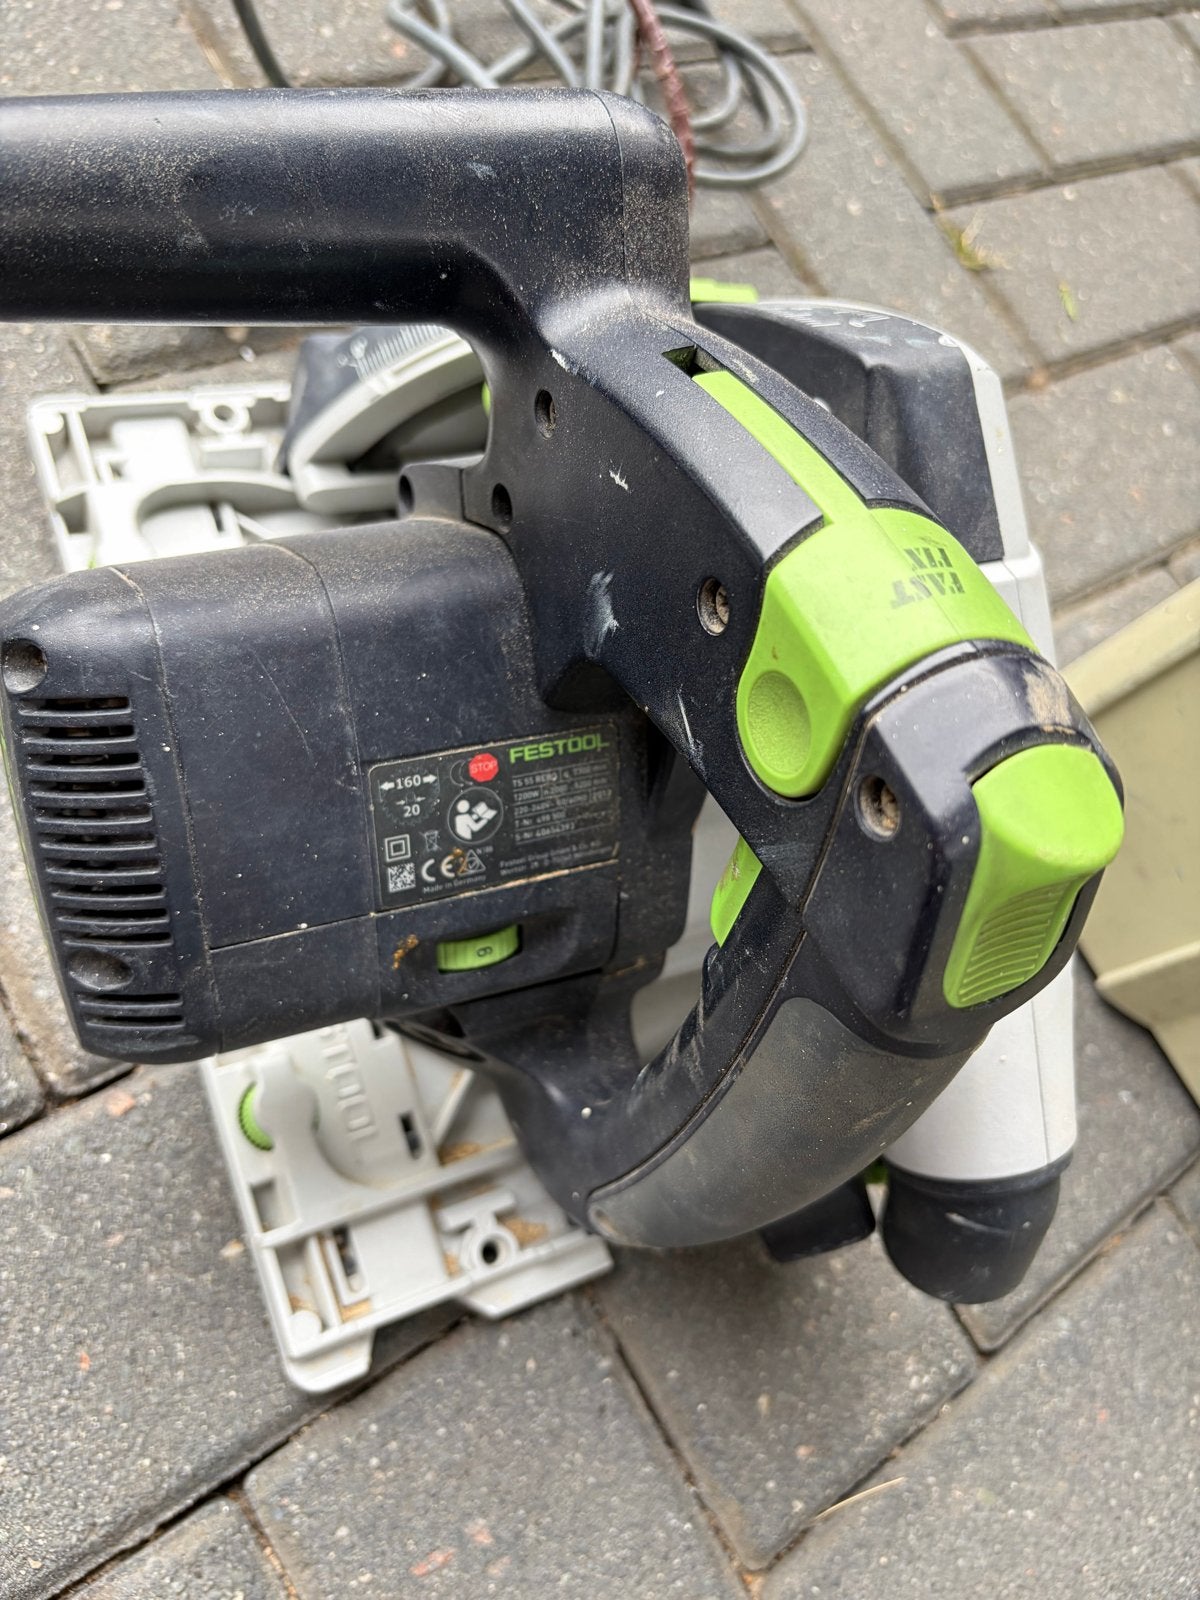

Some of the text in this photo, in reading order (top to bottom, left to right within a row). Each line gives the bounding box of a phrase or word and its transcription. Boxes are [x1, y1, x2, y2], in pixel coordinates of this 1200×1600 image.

[903, 547, 953, 571] FIX
[890, 571, 965, 610] FAST
[509, 733, 609, 763] FESTOOL
[469, 761, 498, 774] STOP
[396, 774, 421, 790] 160
[403, 804, 420, 818] 20
[423, 883, 443, 894] Made
[454, 875, 487, 888] Germany
